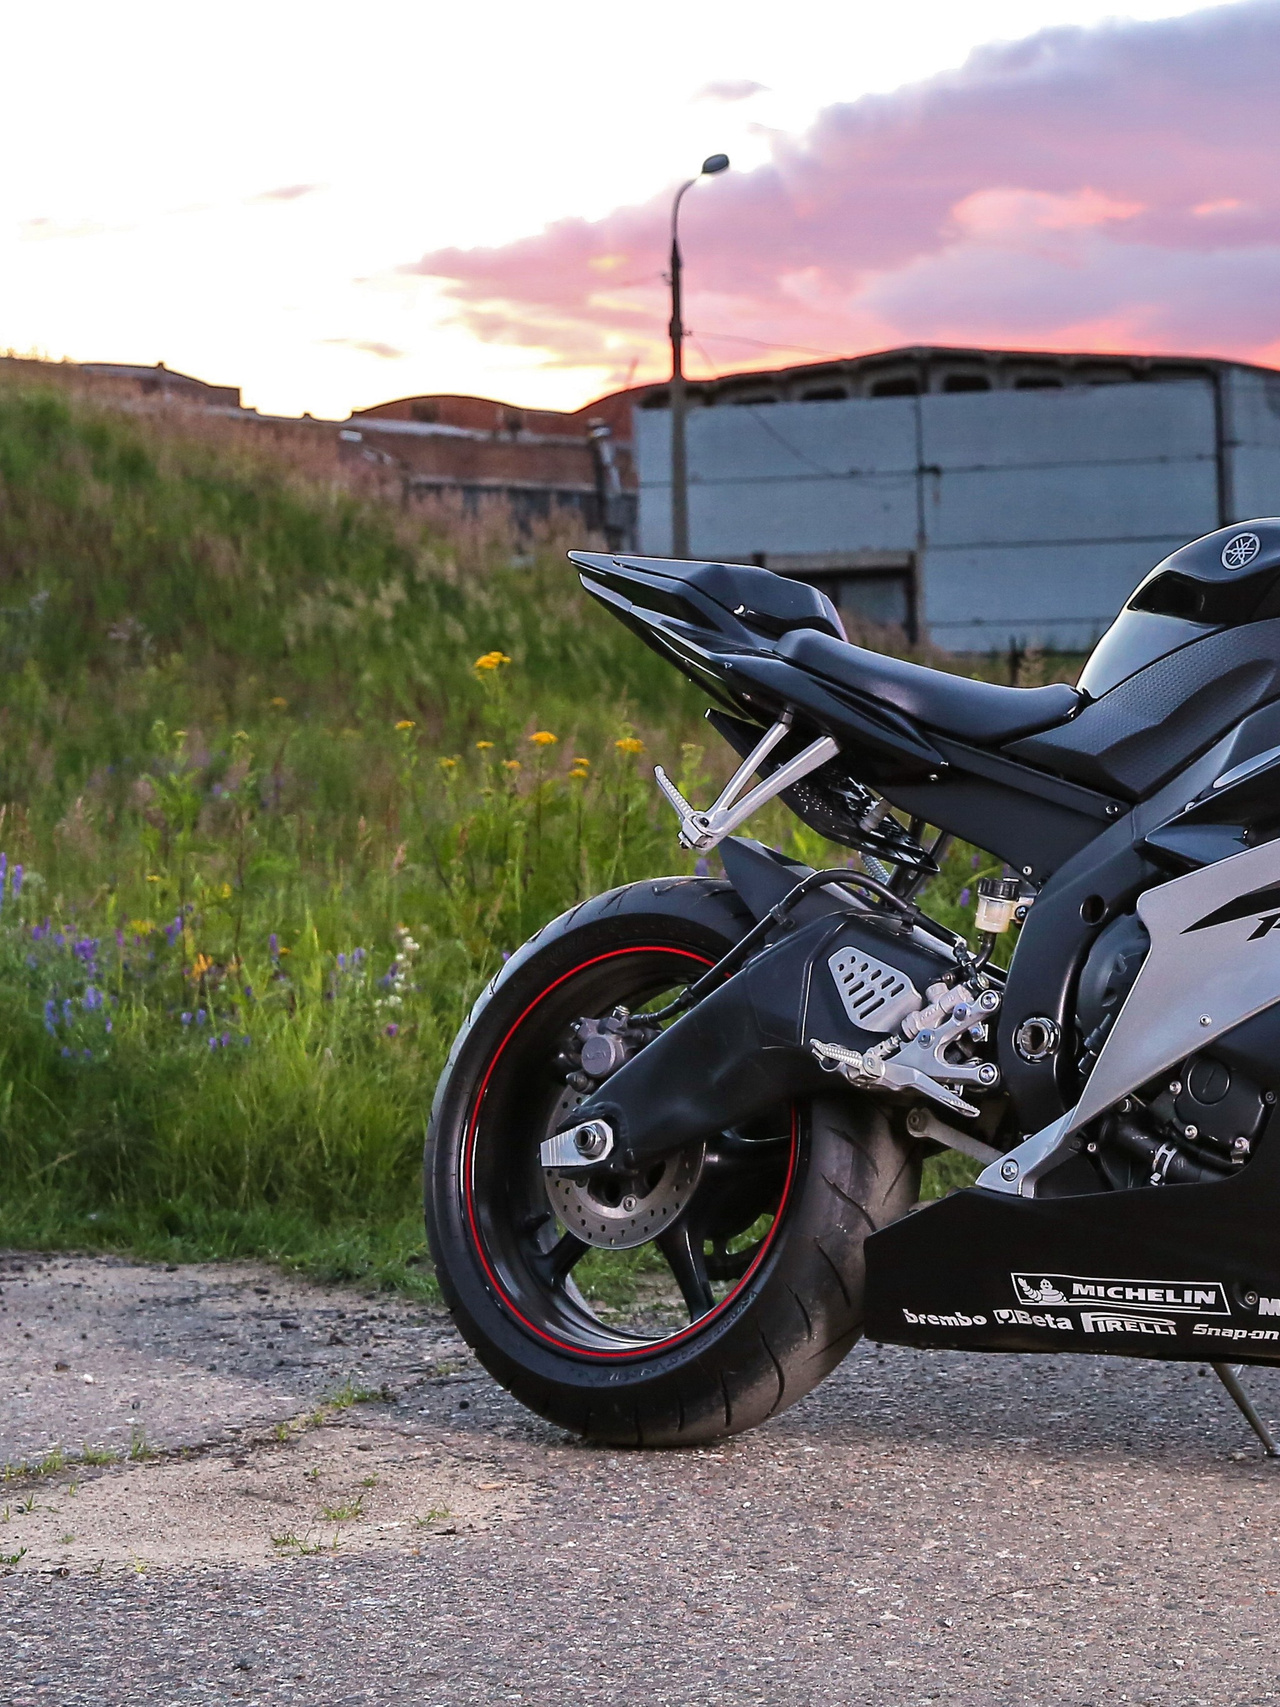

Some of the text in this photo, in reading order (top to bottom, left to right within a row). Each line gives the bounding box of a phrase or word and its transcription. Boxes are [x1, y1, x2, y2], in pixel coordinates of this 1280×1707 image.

[1072, 1282, 1217, 1305] MICHELIN
[902, 1308, 988, 1327] brembo
[1013, 1309, 1075, 1331] Beta
[1079, 1311, 1178, 1336] PIRELLI
[1192, 1323, 1280, 1341] Snap-on
